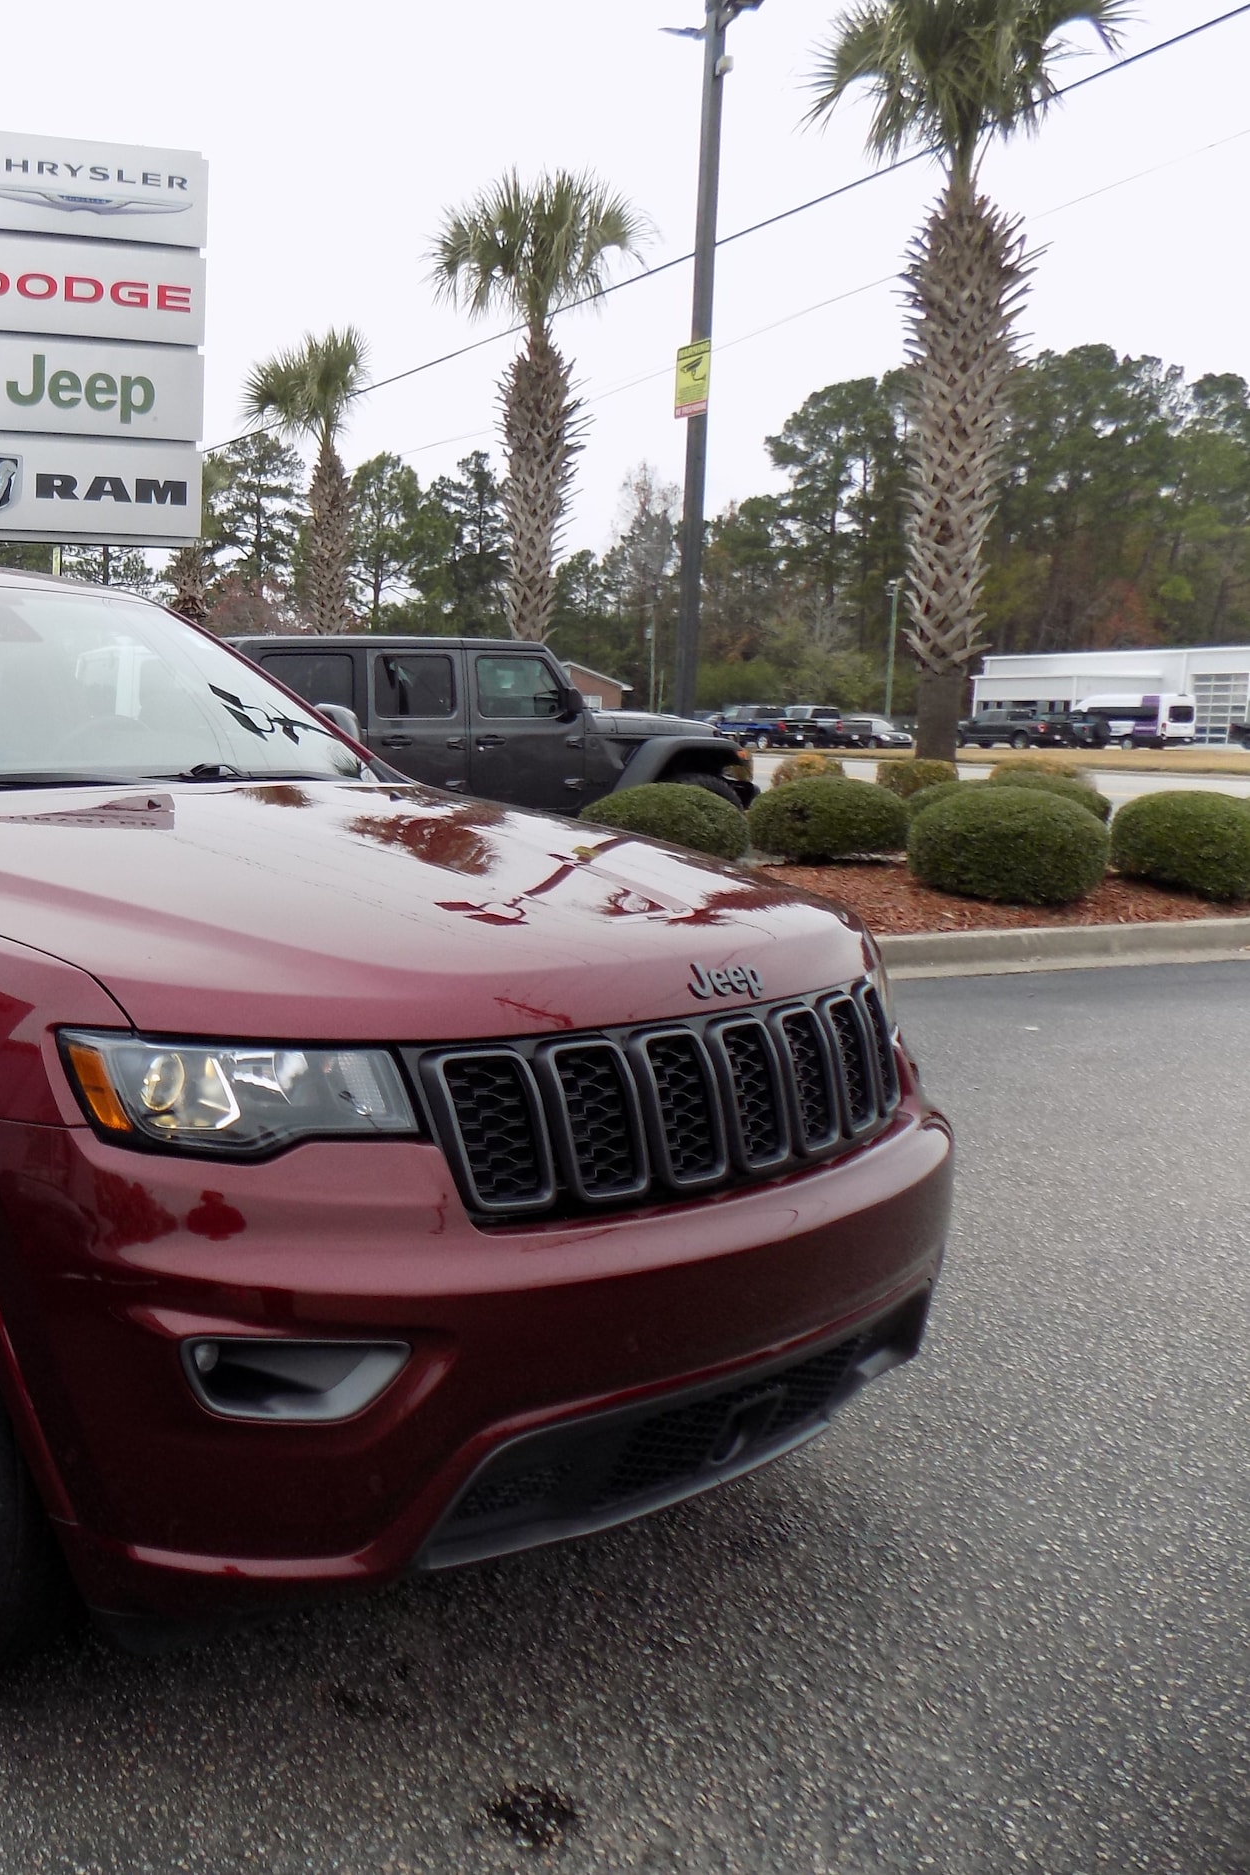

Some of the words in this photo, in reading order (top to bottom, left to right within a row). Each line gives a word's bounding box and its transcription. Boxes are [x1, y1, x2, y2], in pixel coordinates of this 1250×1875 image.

[6, 354, 156, 424] Jeep
[36, 473, 187, 506] RAM
[687, 961, 764, 1000] Jeep
